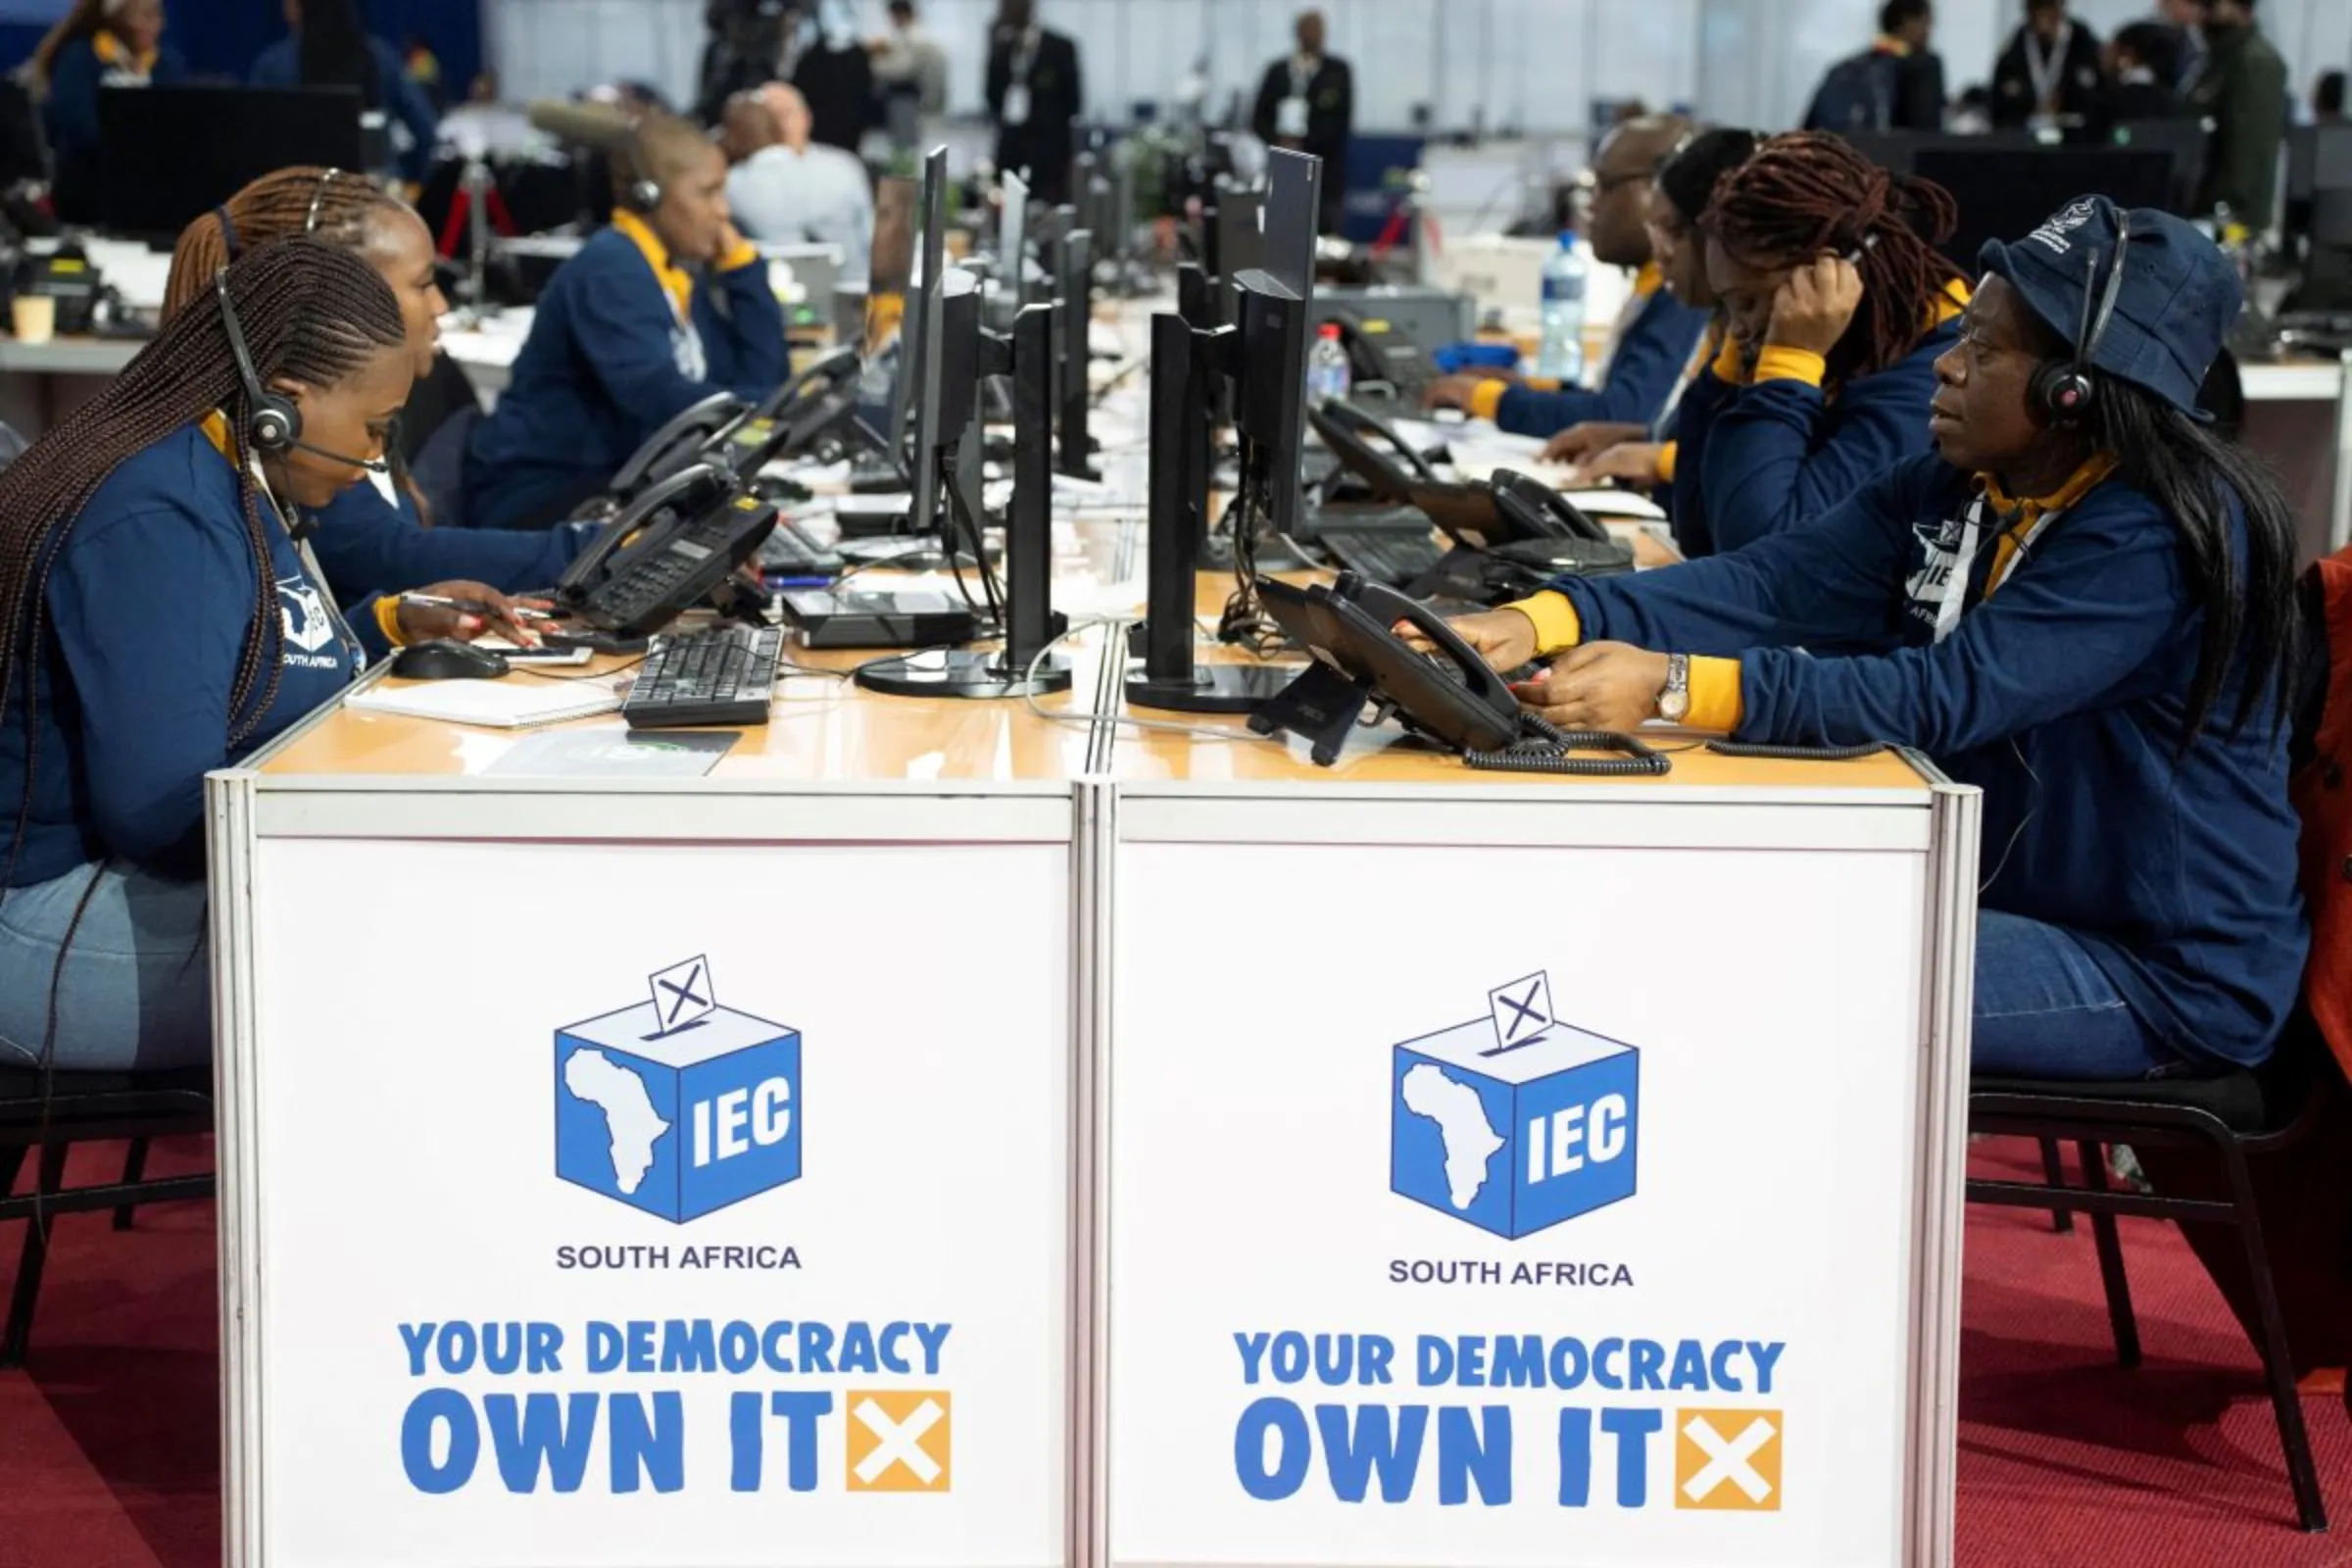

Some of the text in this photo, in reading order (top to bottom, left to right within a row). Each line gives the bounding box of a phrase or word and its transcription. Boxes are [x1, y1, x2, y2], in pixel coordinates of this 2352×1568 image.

[1927, 564, 1953, 587] IE
[282, 654, 309, 667] OUTH
[693, 1076, 790, 1168] IEC
[1527, 1093, 1628, 1185] IEC
[556, 1246, 803, 1270] SOUTH AFRICA
[1388, 1259, 1635, 1288] SOUTH AFRICA
[397, 1318, 953, 1377] YOUR DEMOCRACY
[1232, 1330, 1787, 1396] YOUR DEMOCRACY
[400, 1387, 834, 1494] OWN IT
[1234, 1396, 1664, 1509] OWN IT
